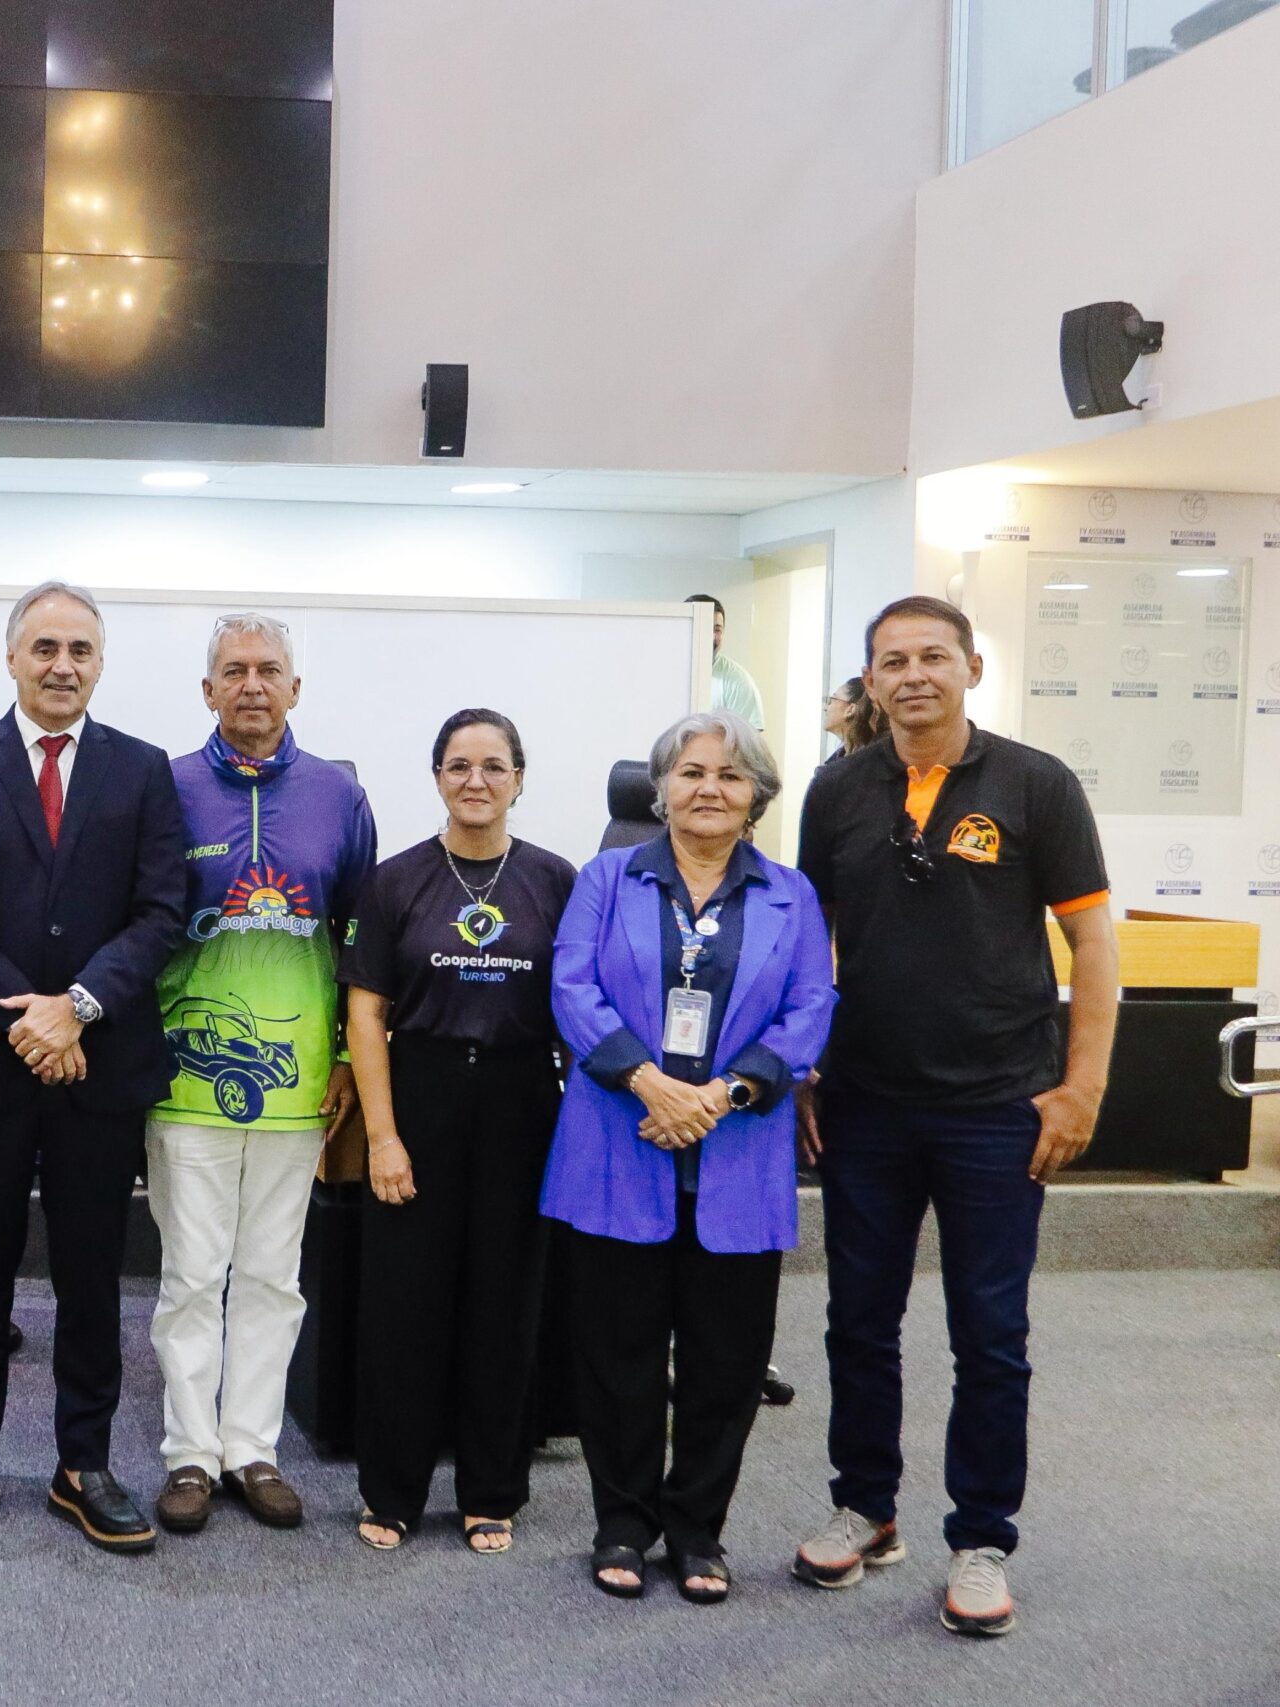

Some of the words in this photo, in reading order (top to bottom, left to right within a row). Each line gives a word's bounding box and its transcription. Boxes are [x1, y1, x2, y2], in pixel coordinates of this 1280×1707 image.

[187, 907, 318, 942] Cooperbuggy
[430, 953, 532, 971] CooperJampa
[458, 971, 506, 982] TURISMO
